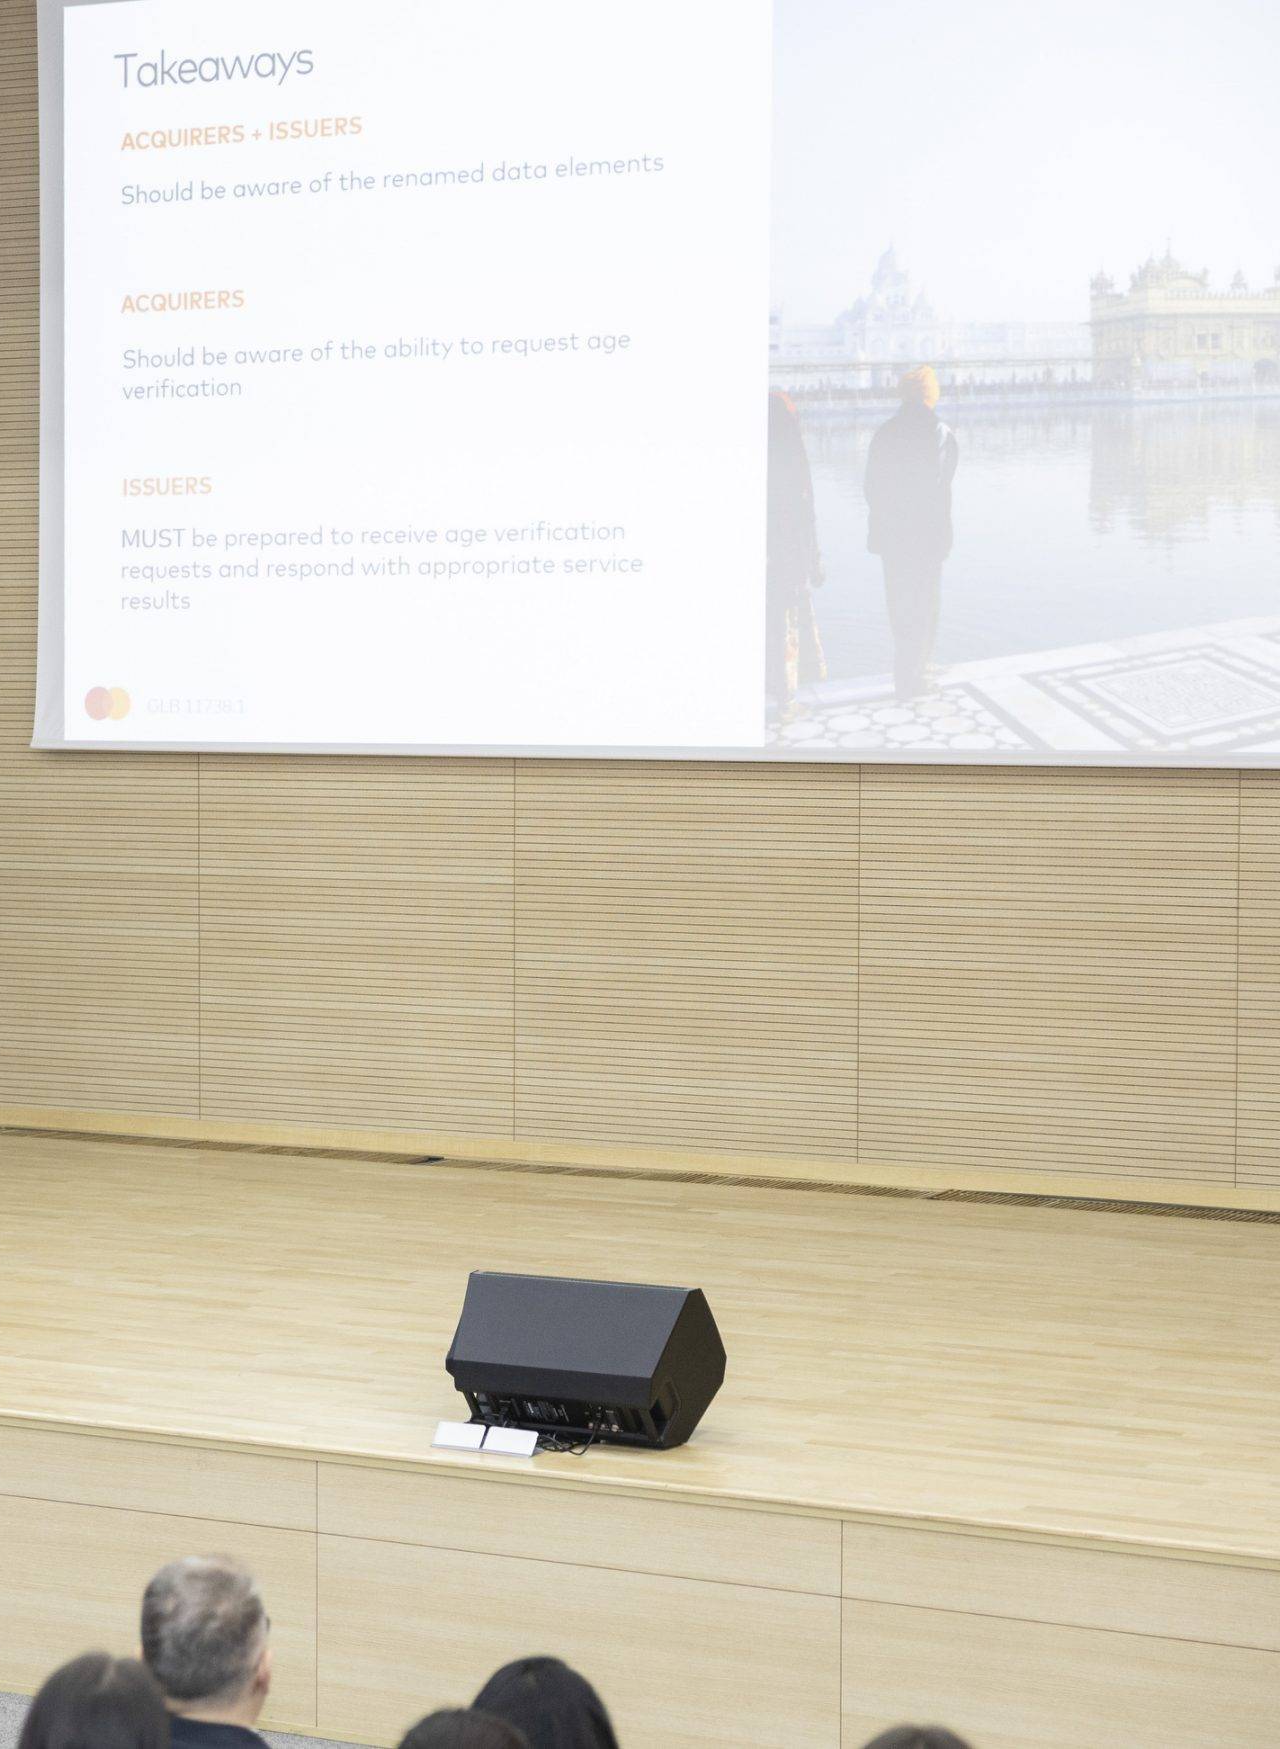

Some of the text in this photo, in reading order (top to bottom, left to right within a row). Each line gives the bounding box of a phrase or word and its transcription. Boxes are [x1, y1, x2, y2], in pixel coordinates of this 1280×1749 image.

[113, 48, 314, 88] Takeaways
[120, 116, 363, 151] ACQUIRERS + ISSUERS
[121, 153, 664, 207] Should be aware of the renamed data elements
[120, 289, 245, 313] ACQUIRERS
[123, 333, 631, 369] Should be aware of the ability to request age
[122, 377, 241, 400] verification
[122, 476, 213, 496] ISSUERS
[122, 520, 625, 551] MUST be prepared to receive age verification
[121, 554, 643, 584] requests and respond with appropriate service
[121, 590, 190, 610] results
